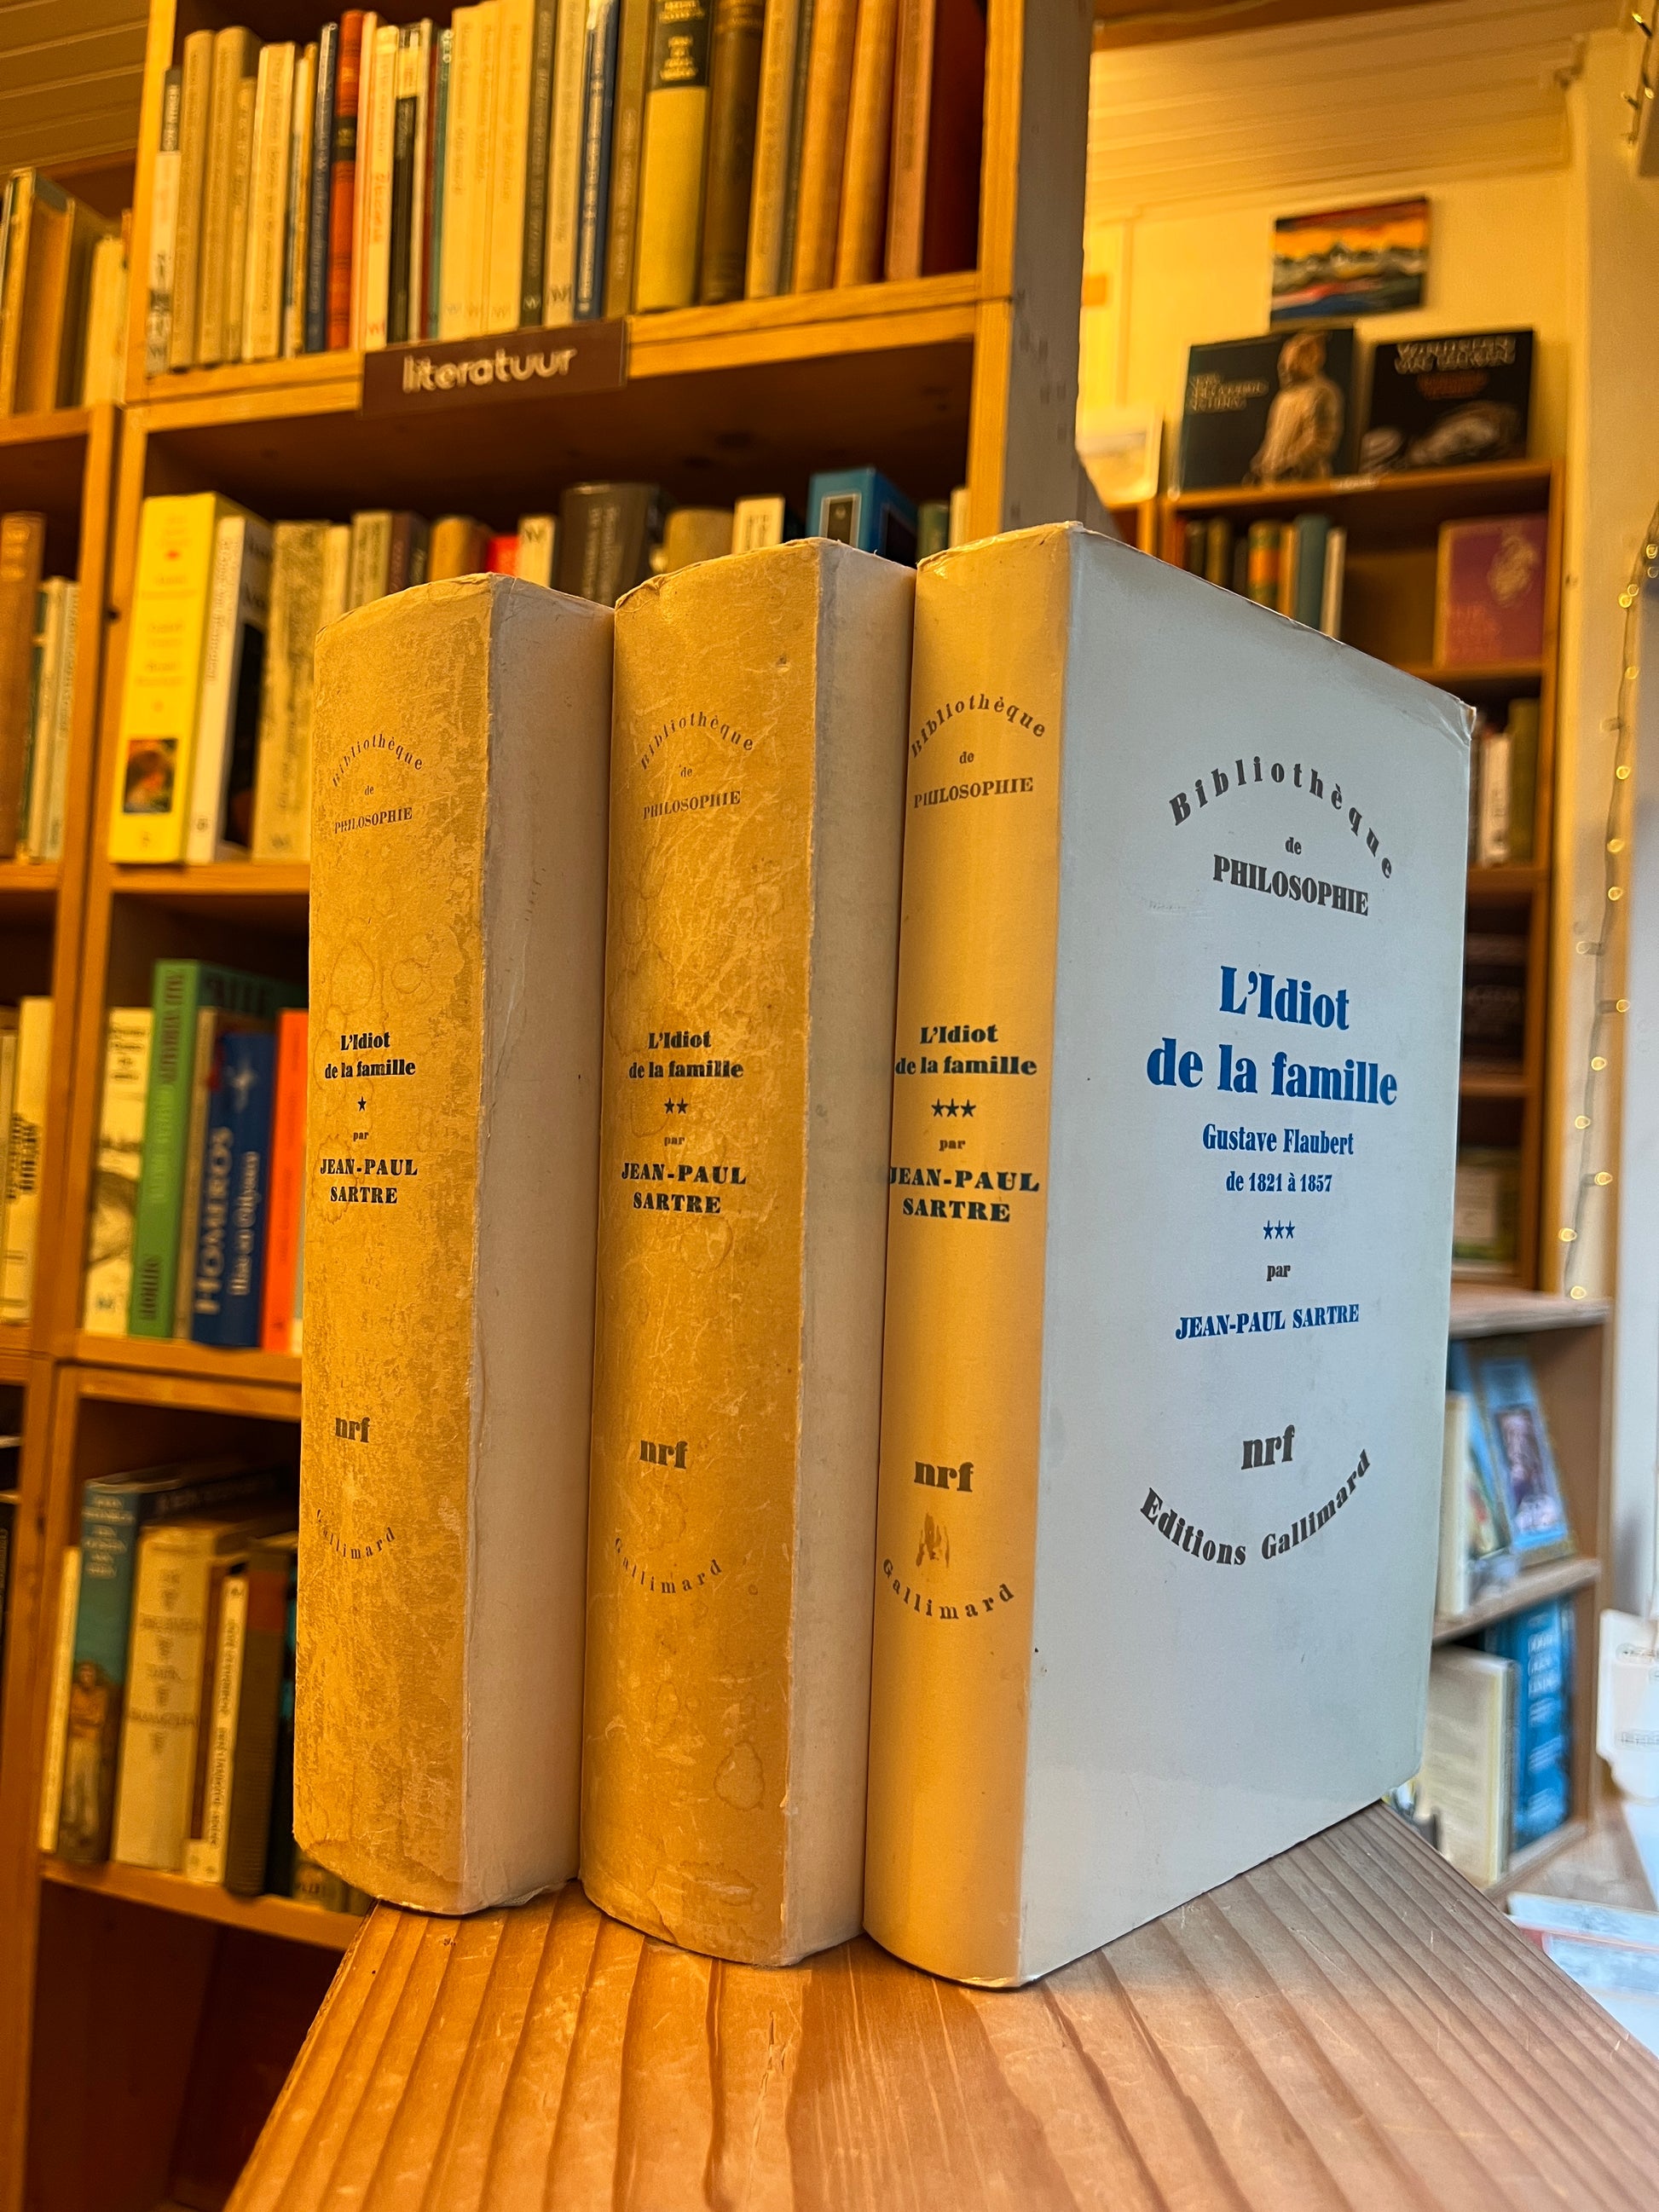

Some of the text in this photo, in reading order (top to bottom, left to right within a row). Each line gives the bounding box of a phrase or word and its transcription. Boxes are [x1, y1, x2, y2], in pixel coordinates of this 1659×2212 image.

[402, 348, 577, 394] literatuur
[910, 693, 1046, 759] Bibliothèque
[959, 751, 974, 764] de
[680, 766, 692, 777] de
[364, 785, 374, 795] de
[914, 777, 1033, 808] PHILOSOPHIE
[643, 790, 741, 820] PHILOSOPHIE
[1169, 755, 1392, 879] Bibliothèque
[334, 807, 413, 835] PHILOSOPHIE
[1285, 836, 1302, 855] de
[1212, 853, 1368, 916] PHILOSOPHIE
[325, 1059, 416, 1079] de la famille
[628, 1060, 744, 1079] de la famille
[894, 1055, 1038, 1075] de la famille
[1147, 1037, 1397, 1106] de la famille
[353, 1131, 369, 1142] par
[664, 1136, 685, 1147] par
[939, 1139, 966, 1152] par
[1203, 1123, 1354, 1155] Gustave Flaubert
[320, 1158, 418, 1176] JEAN-PAUL
[621, 1162, 747, 1185] JEAN-PAUL
[888, 1165, 1040, 1192] JEAN-PAUL
[1226, 1170, 1332, 1192] de 1821 à 1857
[330, 1186, 398, 1204] SARTRE
[633, 1192, 721, 1214] SARTRE
[902, 1198, 1011, 1222] SARTRE
[1266, 1264, 1291, 1281] par
[1175, 1303, 1360, 1340] JEAN-PAUL SARTRE
[335, 1417, 371, 1443] nrf
[639, 1440, 689, 1470] nrf
[1241, 1424, 1295, 1470] nrf
[914, 1461, 974, 1493] nrf
[1140, 1448, 1371, 1565] Editions Gallimard
[615, 1538, 722, 1594] Gallimard
[883, 1558, 1014, 1620] Gallimard
